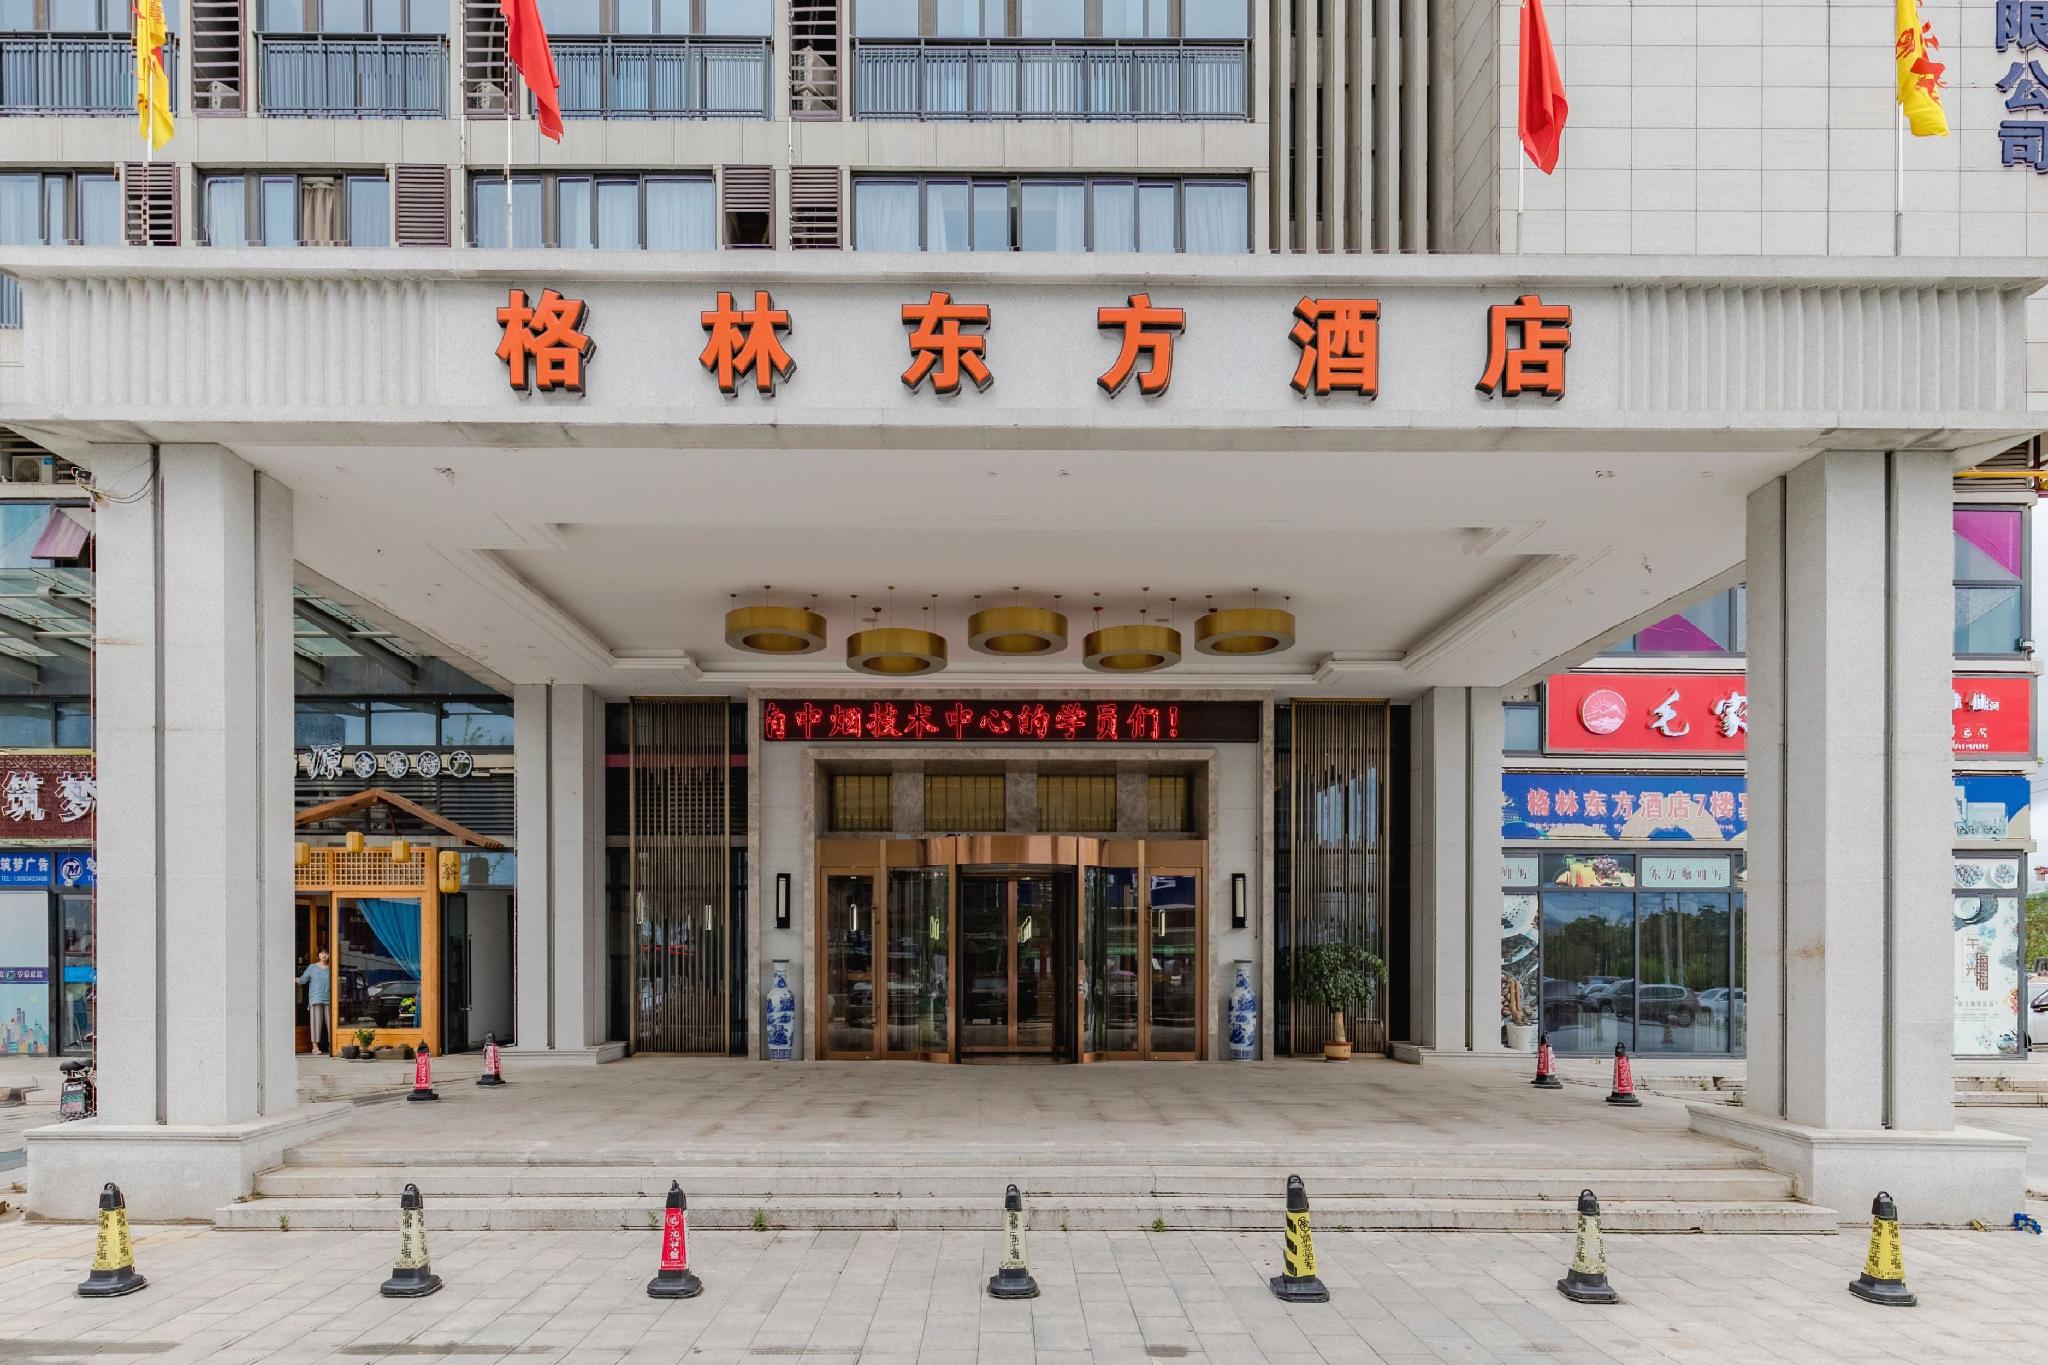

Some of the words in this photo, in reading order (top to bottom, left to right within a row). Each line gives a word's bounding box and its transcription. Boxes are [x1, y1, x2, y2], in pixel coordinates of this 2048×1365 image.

[496, 288, 1573, 398] 格林东方酒店
[1527, 788, 1745, 820] 格林东方酒店7楼
